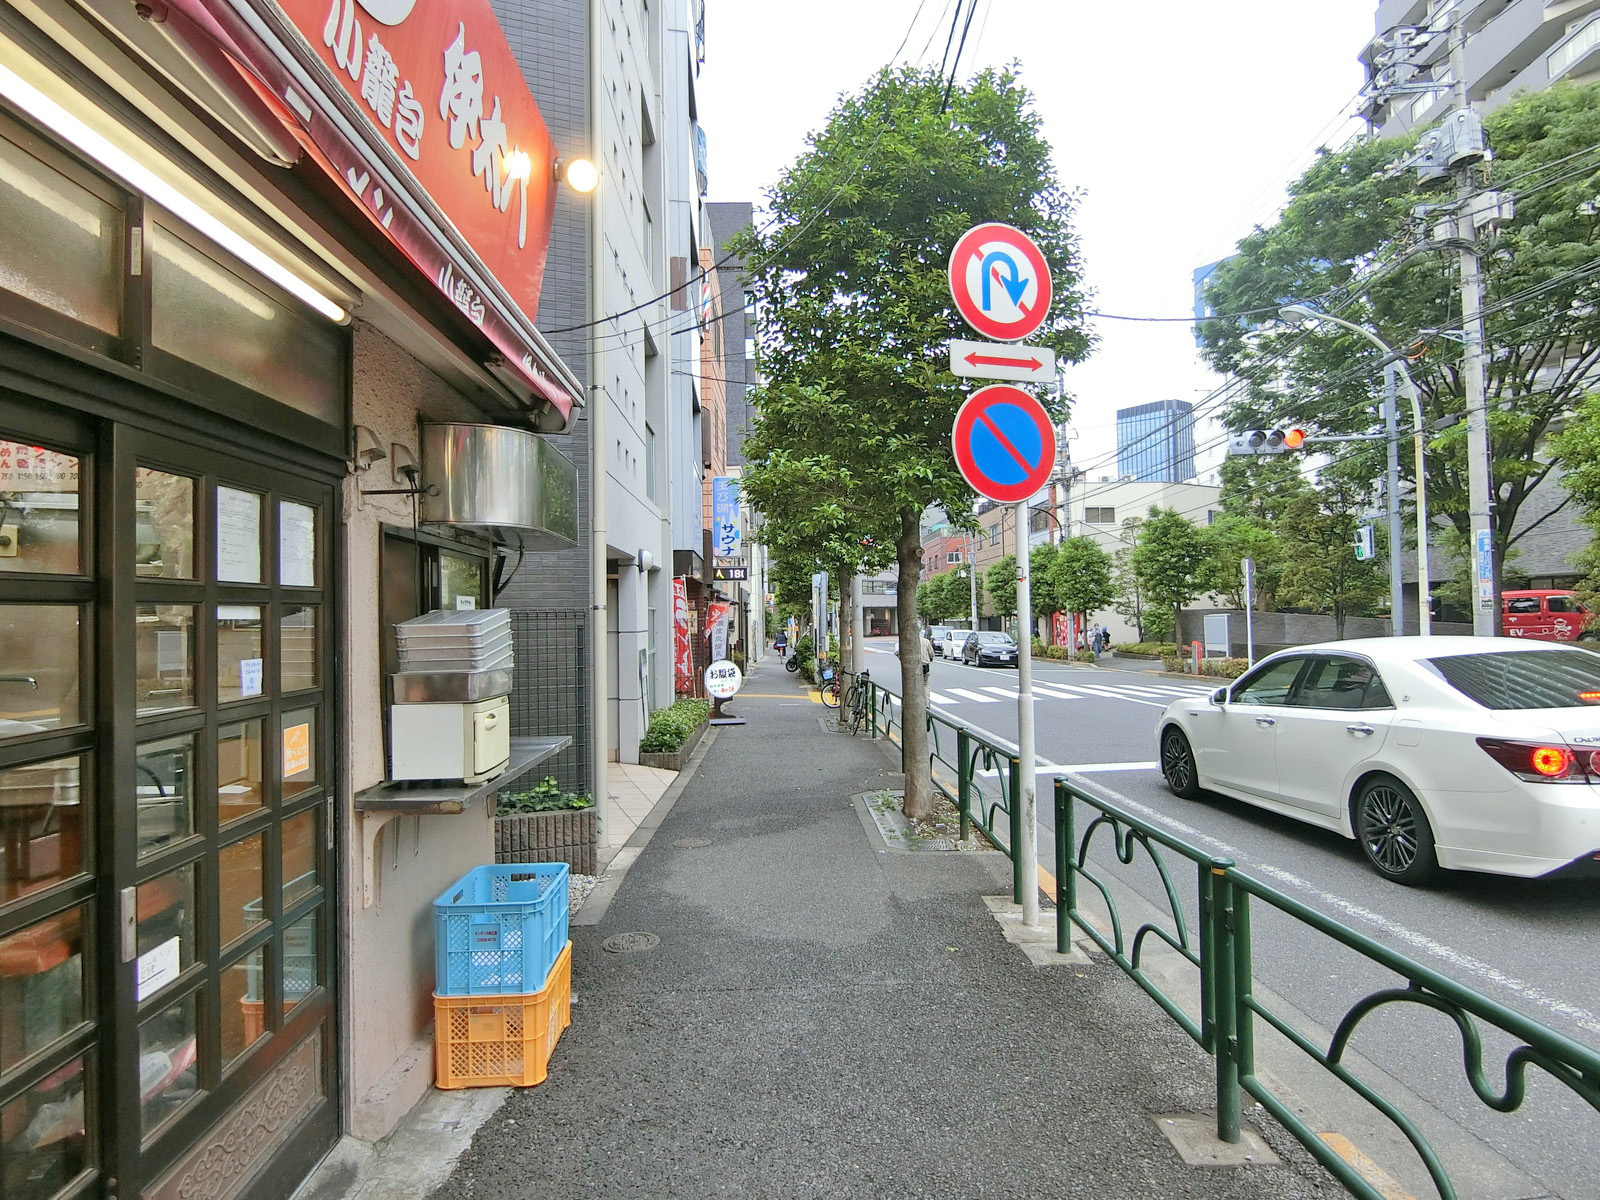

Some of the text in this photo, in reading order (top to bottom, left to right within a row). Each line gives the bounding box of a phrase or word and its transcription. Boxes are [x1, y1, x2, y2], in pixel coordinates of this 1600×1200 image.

[324, 0, 424, 160] 小籠包
[721, 523, 735, 556] サウナ
[1509, 628, 1524, 636] EV
[709, 667, 736, 680] お腹袋
